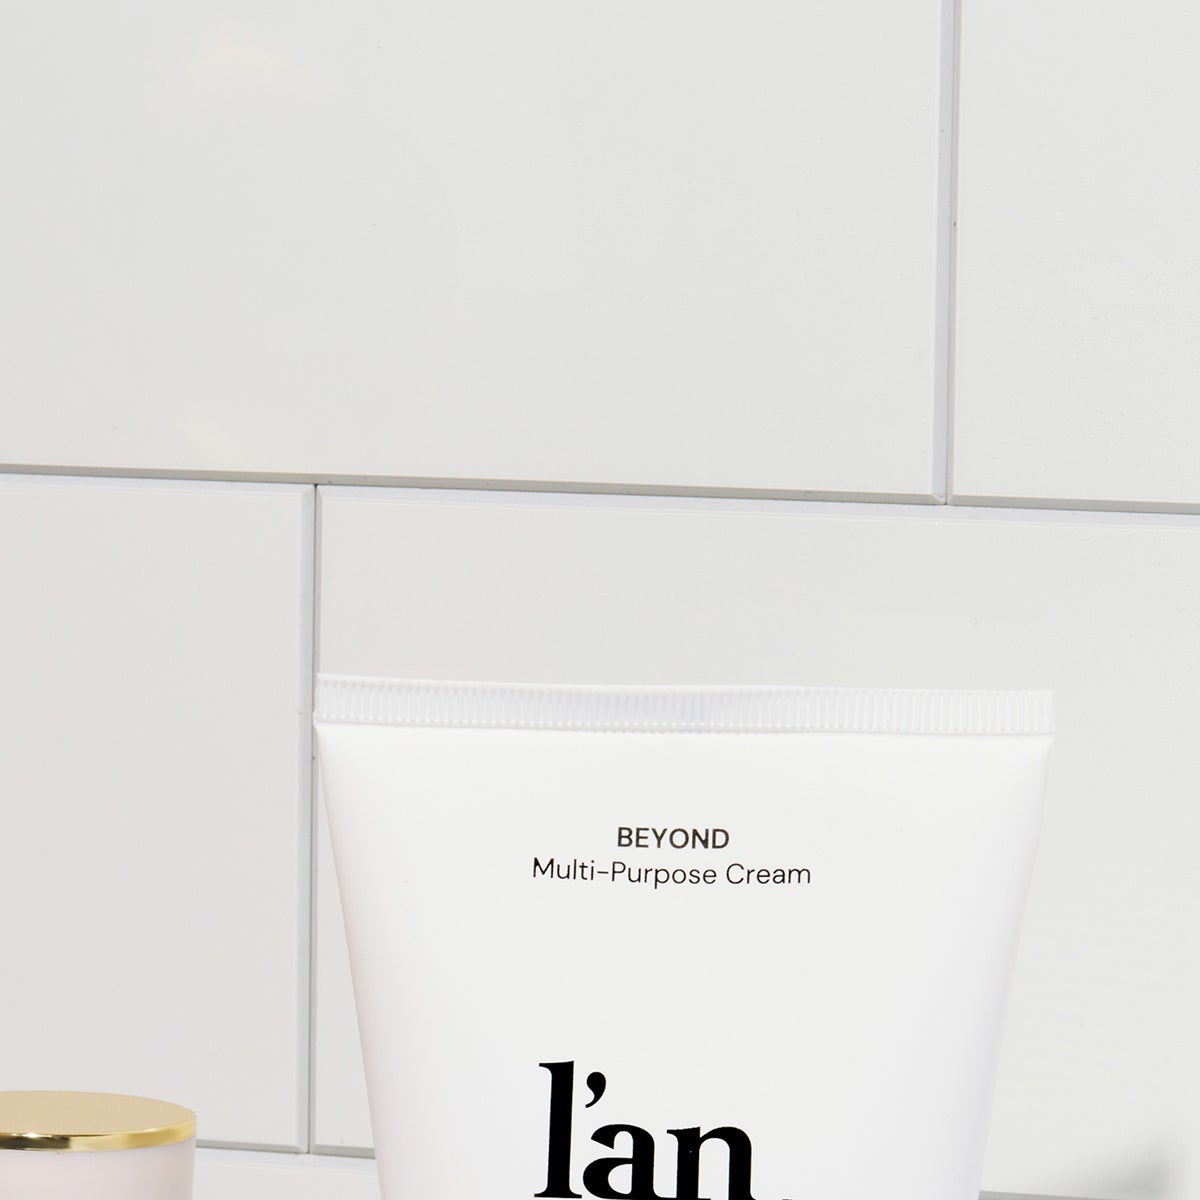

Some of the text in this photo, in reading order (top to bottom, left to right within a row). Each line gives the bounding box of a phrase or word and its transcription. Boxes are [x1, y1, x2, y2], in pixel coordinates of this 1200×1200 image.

[617, 826, 730, 849] BEYOND
[532, 857, 811, 890] Multi-Purpose Cream
